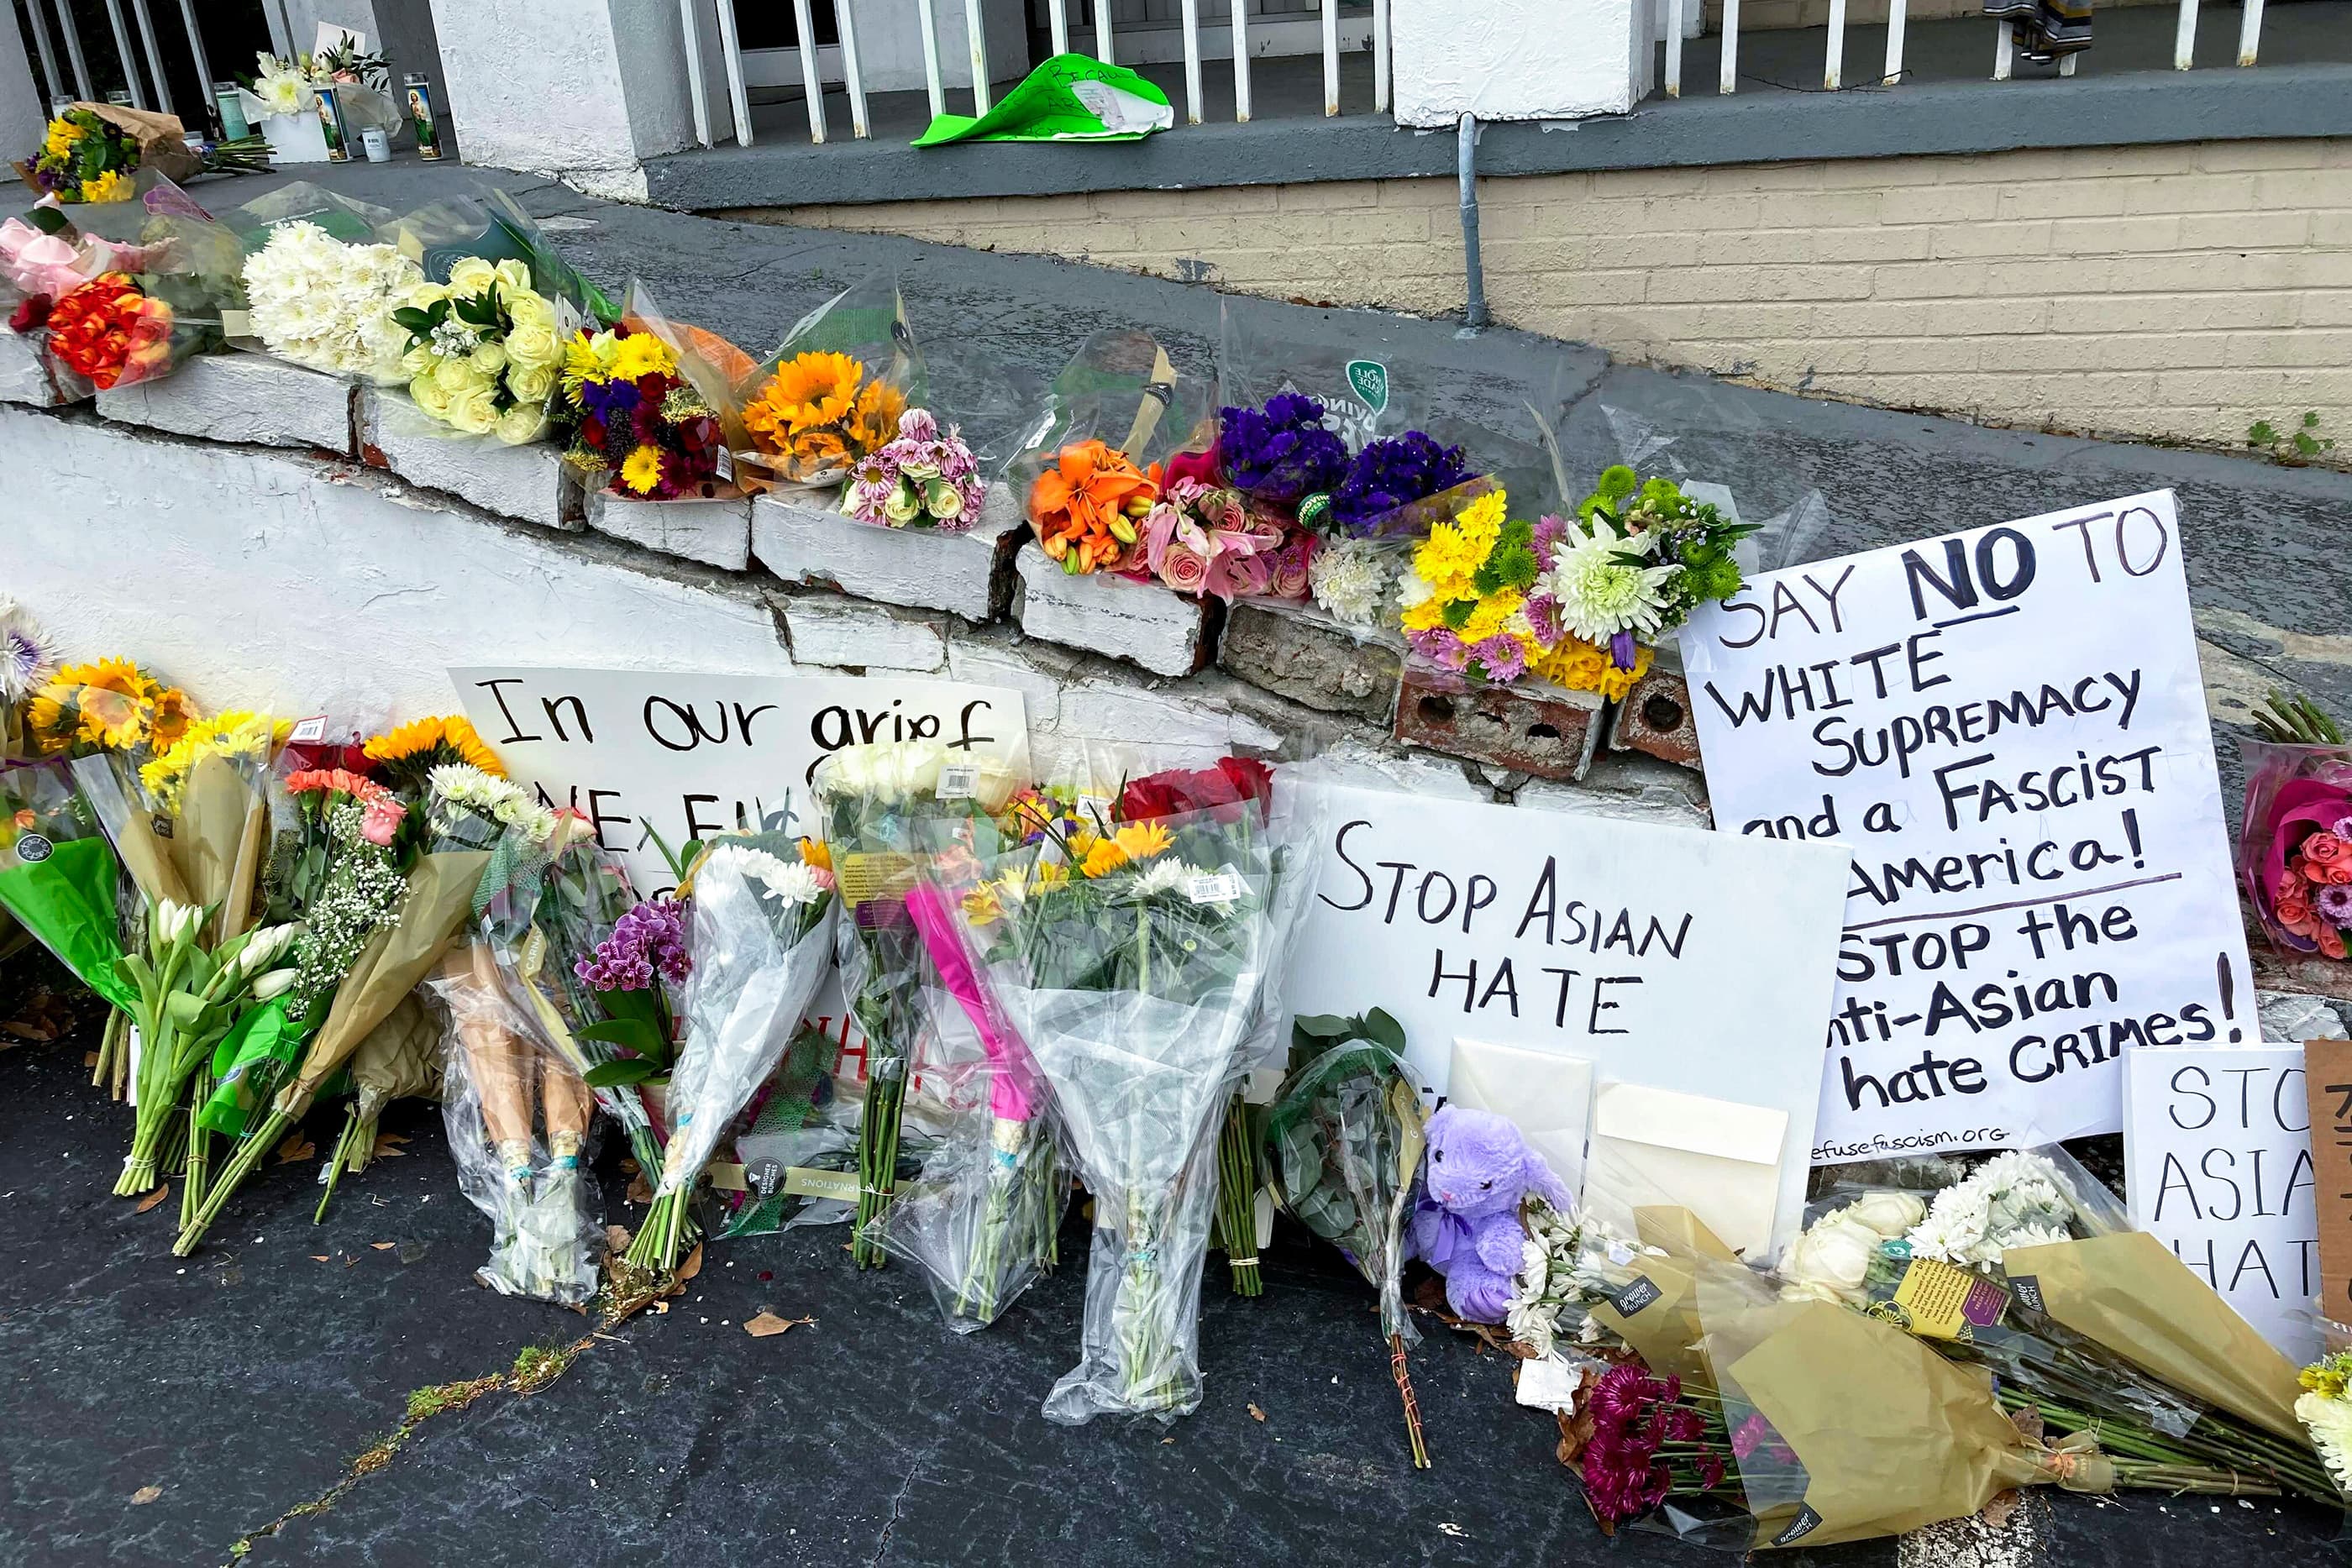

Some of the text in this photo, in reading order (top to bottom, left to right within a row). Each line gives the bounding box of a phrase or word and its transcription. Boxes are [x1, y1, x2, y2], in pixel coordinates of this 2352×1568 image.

[1049, 64, 1122, 89] BECAU
[1299, 495, 1331, 525] MPROVIN
[1719, 506, 2168, 648] SAY NO TO
[1704, 629, 1951, 728] WHITE
[475, 678, 594, 745] In
[1741, 794, 1841, 841] and
[1863, 802, 1903, 834] a
[1317, 819, 1498, 934] STOP
[1836, 903, 2139, 982] STOP the
[1428, 949, 1644, 1035] HATE
[1826, 970, 2118, 1048] nti-Asian
[1841, 1048, 1988, 1111] hate
[2168, 1065, 2311, 1131] STO
[761, 1163, 772, 1194] DESIGNER
[768, 1164, 779, 1194] BUNCHES
[2154, 1147, 2316, 1223] ASIA
[1620, 1282, 1647, 1311] grower
[1627, 1291, 1652, 1311] BUNCH
[2174, 1239, 2319, 1299] HAT
